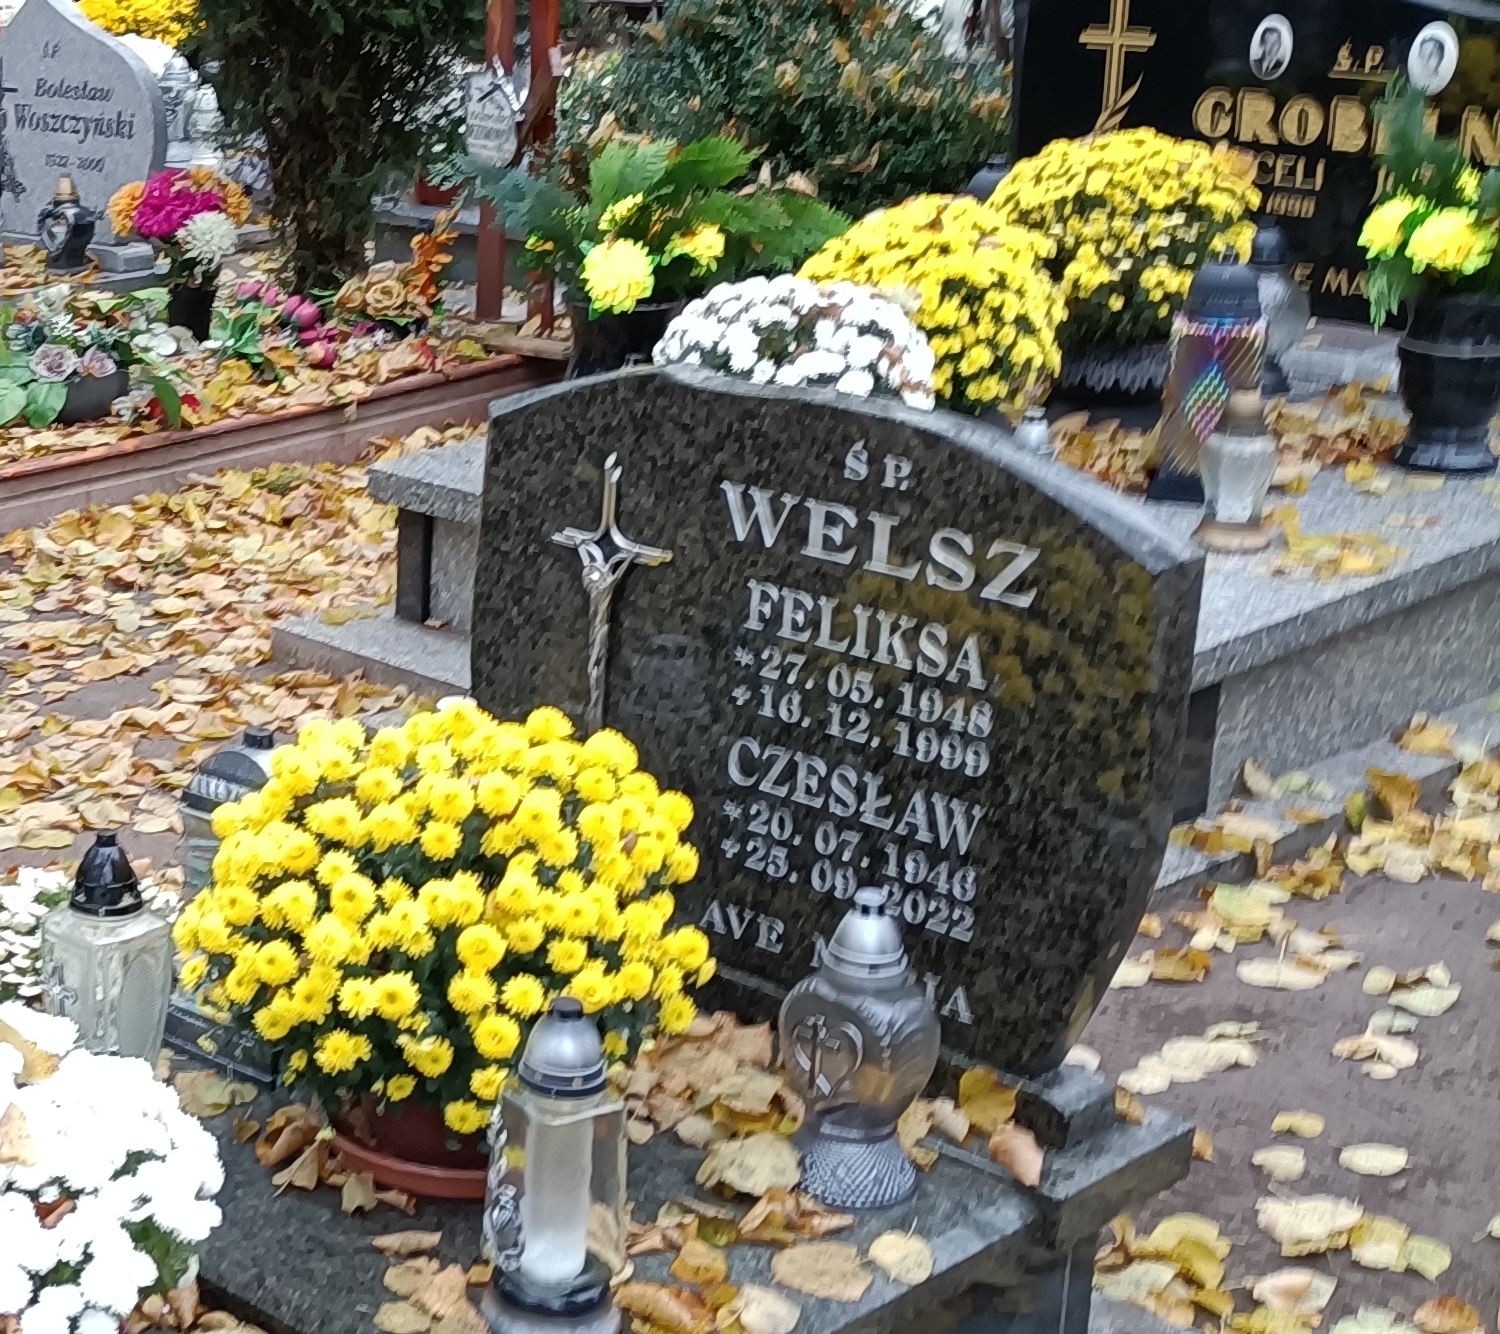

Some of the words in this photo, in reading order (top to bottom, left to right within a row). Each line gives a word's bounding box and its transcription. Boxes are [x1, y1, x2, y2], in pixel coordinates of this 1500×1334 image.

[13, 103, 136, 145] Woszczyński
[1191, 85, 1500, 167] GROBN
[719, 479, 1042, 610] WELSZ
[743, 578, 988, 691] FELIKSA
[893, 720, 991, 778] 1999
[726, 736, 988, 856] CZESŁAW
[699, 899, 786, 954] AVE
